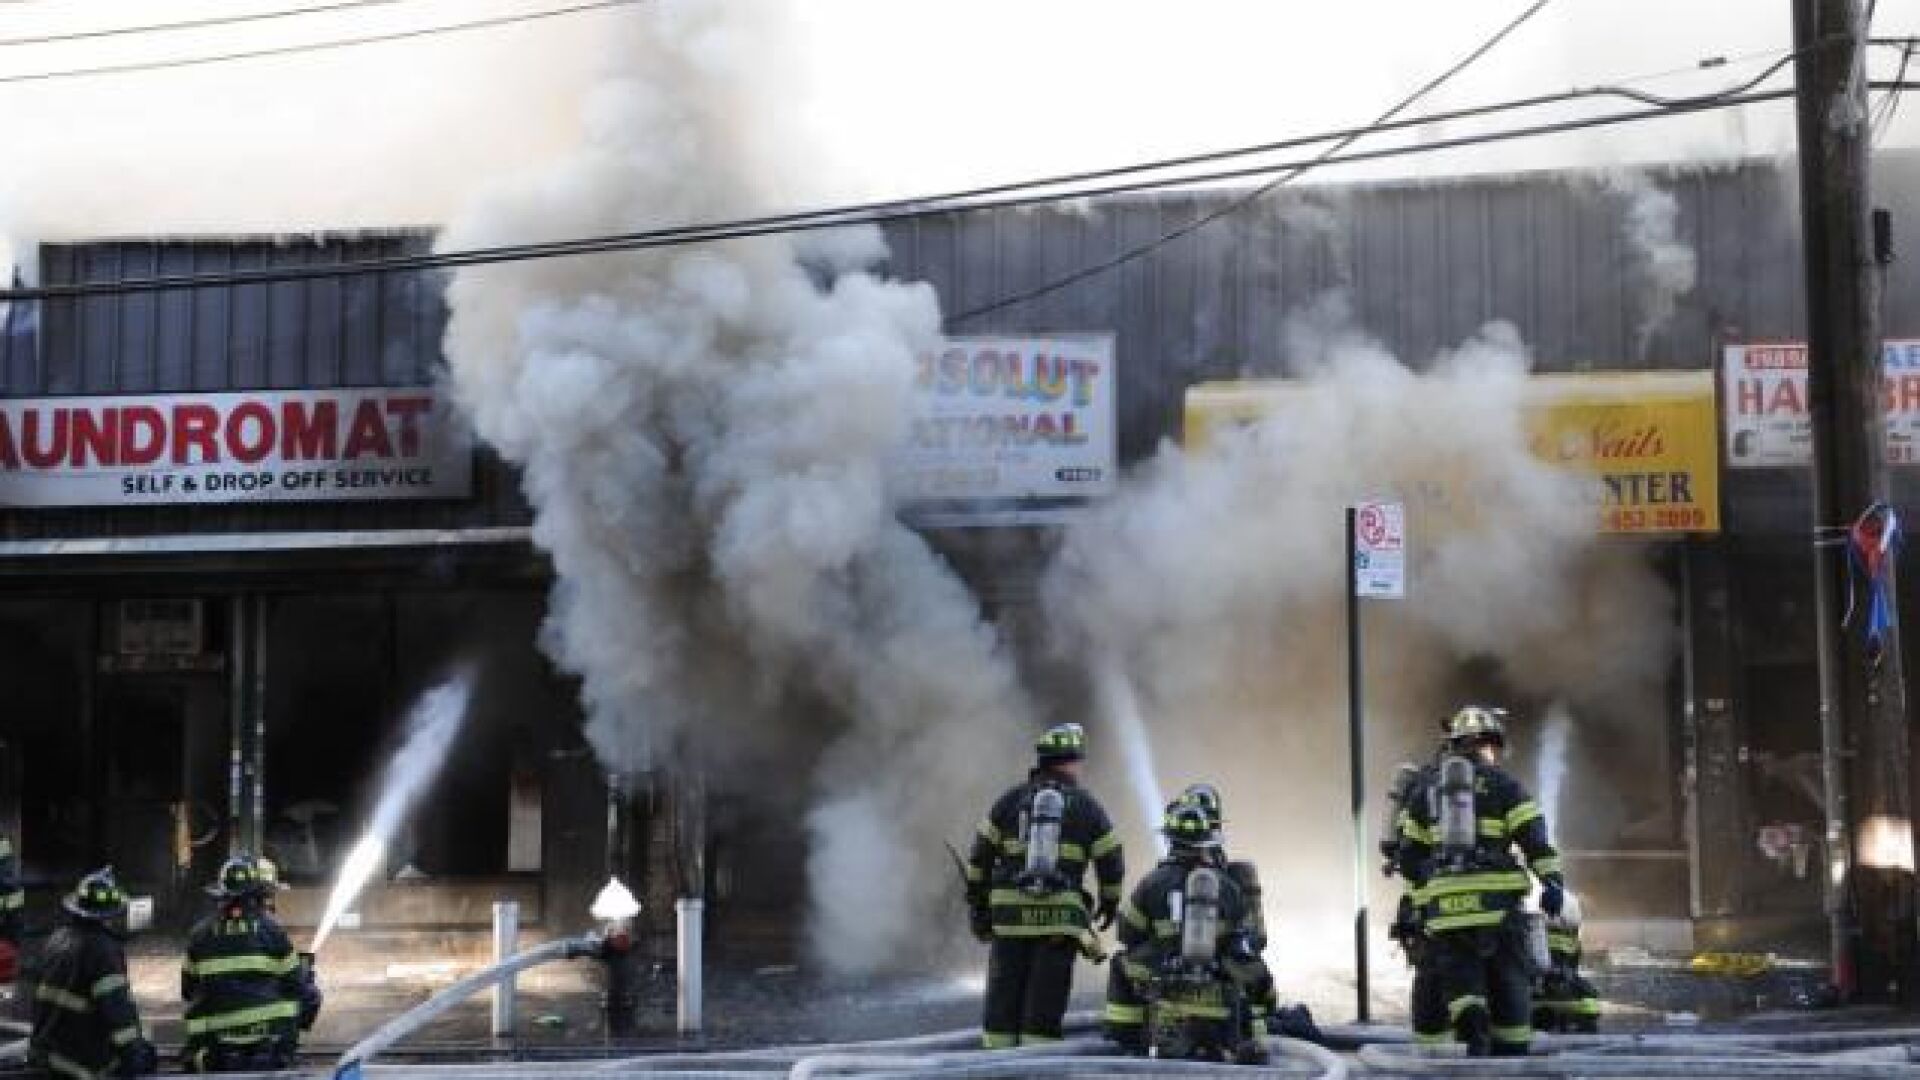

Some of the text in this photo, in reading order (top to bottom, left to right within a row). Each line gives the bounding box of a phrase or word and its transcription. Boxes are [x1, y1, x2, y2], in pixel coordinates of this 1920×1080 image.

[1738, 373, 1809, 416] HA
[121, 467, 434, 495] SELF & DROP OFF SERVICE
[1590, 471, 1694, 506] NTER
